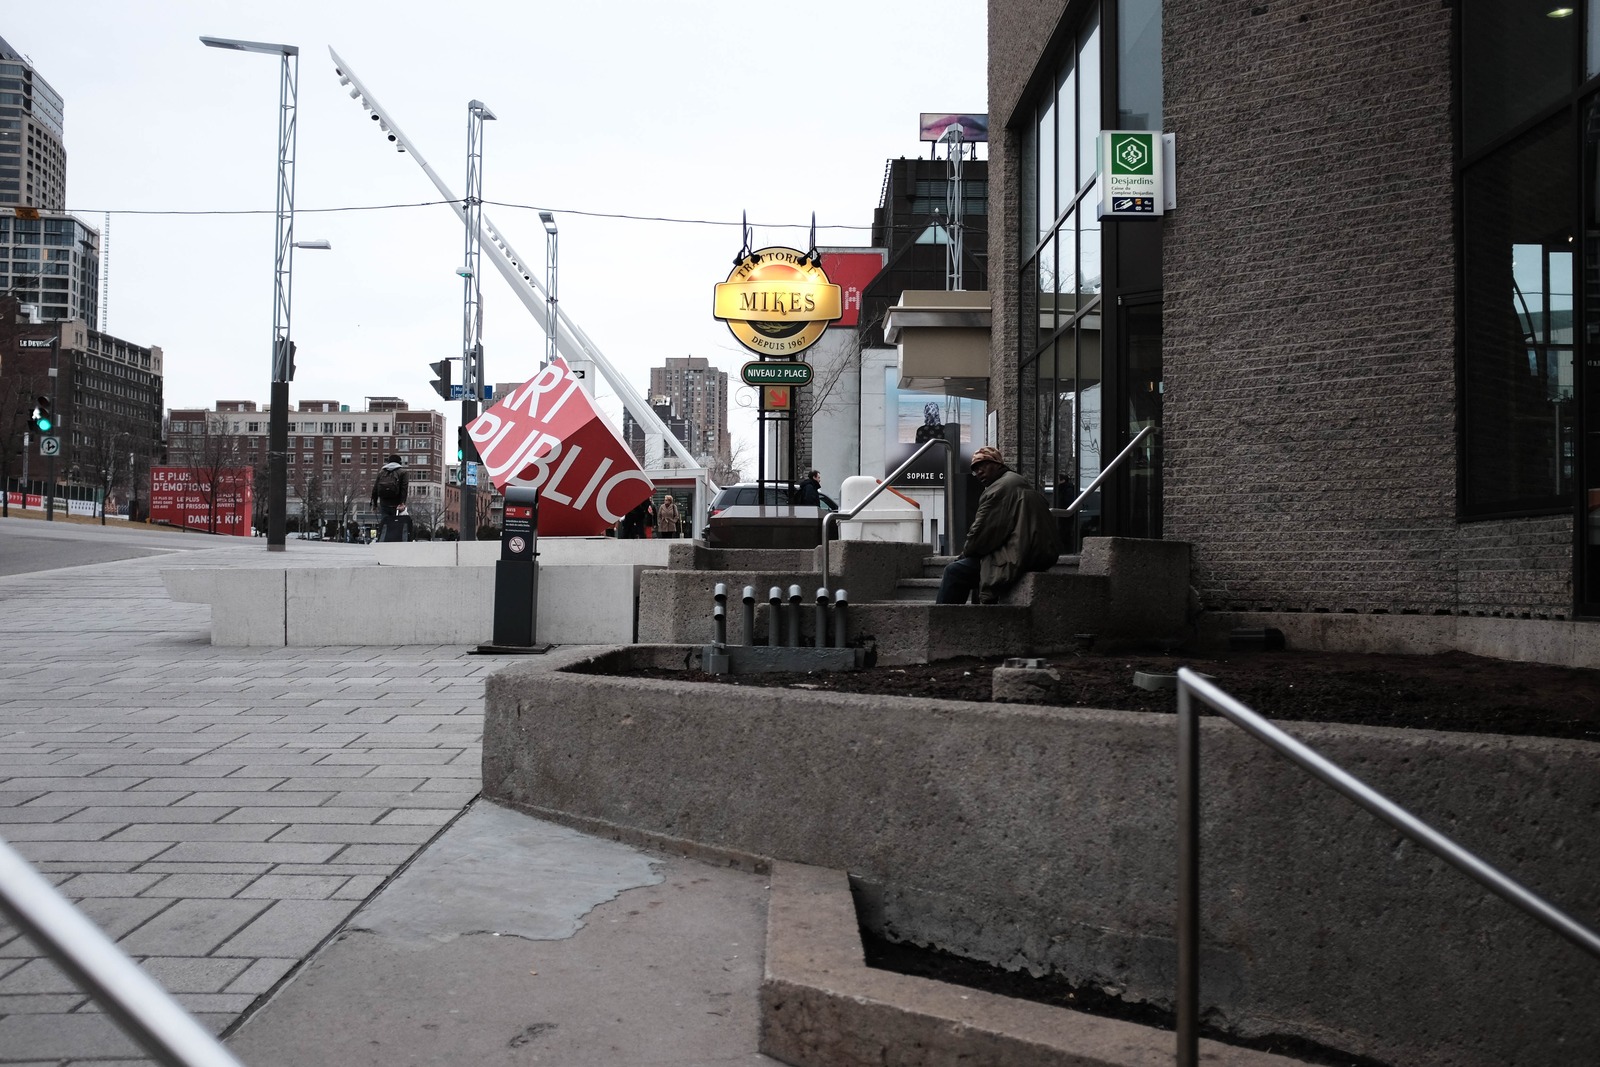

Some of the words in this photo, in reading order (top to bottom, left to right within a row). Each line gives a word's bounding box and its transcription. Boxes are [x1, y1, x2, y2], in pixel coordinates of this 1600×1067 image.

[1112, 177, 1154, 186] Desjardins
[739, 291, 816, 315] MIKES
[751, 336, 785, 350] DEPUIS
[787, 336, 807, 349] 1967
[747, 369, 776, 378] NIVEAU
[777, 369, 782, 378] 2
[784, 369, 807, 378] PLACE
[468, 411, 655, 525] PUBLIC
[153, 472, 164, 481] LE
[167, 472, 191, 481] PLUS
[188, 515, 213, 524] DANS
[216, 515, 222, 523] 1
